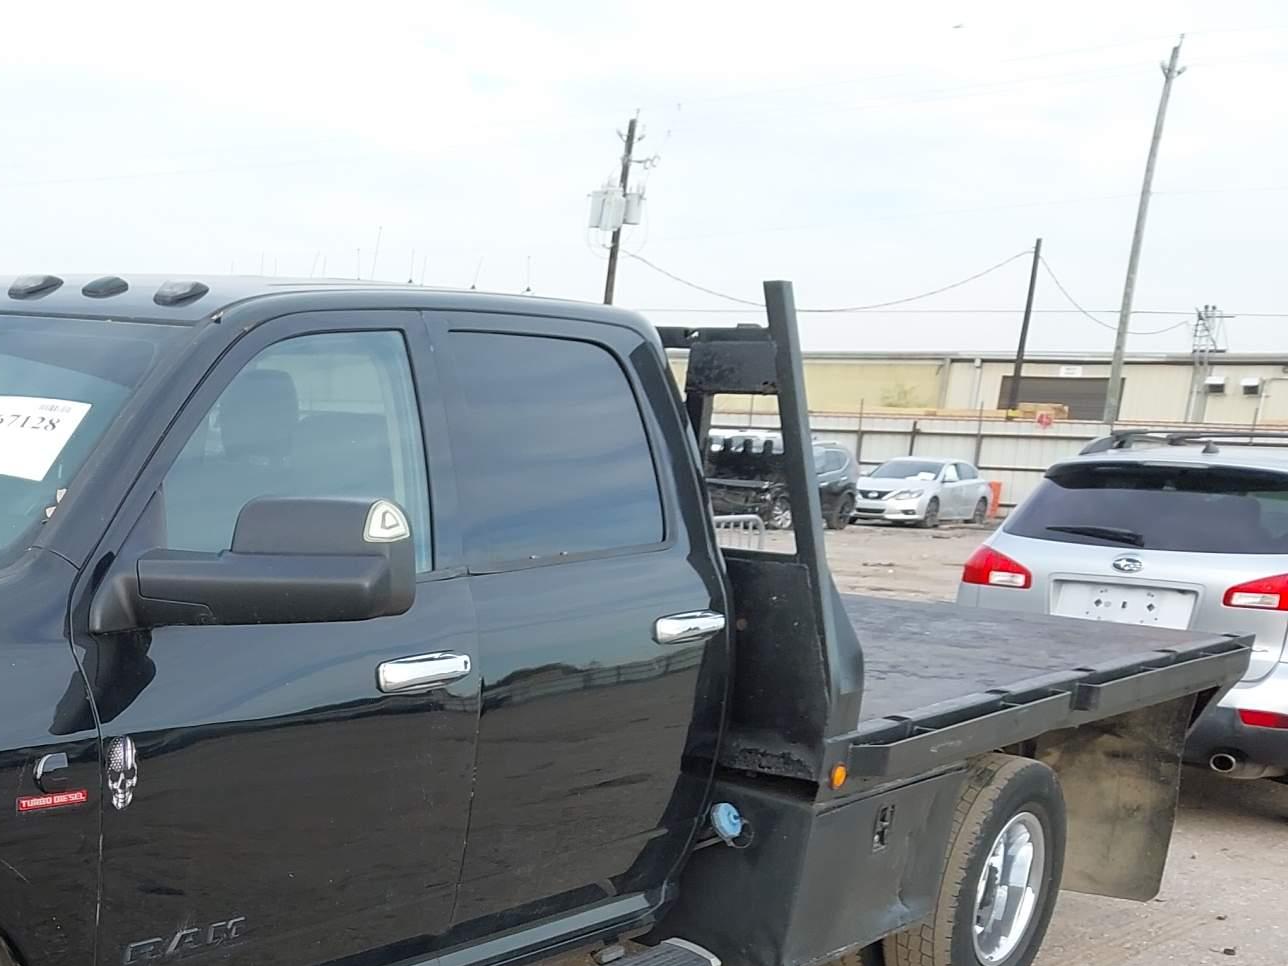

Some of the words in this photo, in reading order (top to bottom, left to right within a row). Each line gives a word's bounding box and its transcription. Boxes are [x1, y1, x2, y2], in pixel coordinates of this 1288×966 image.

[20, 796, 53, 808] TURBO
[53, 791, 87, 804] DIESEL
[123, 915, 247, 966] RAM
